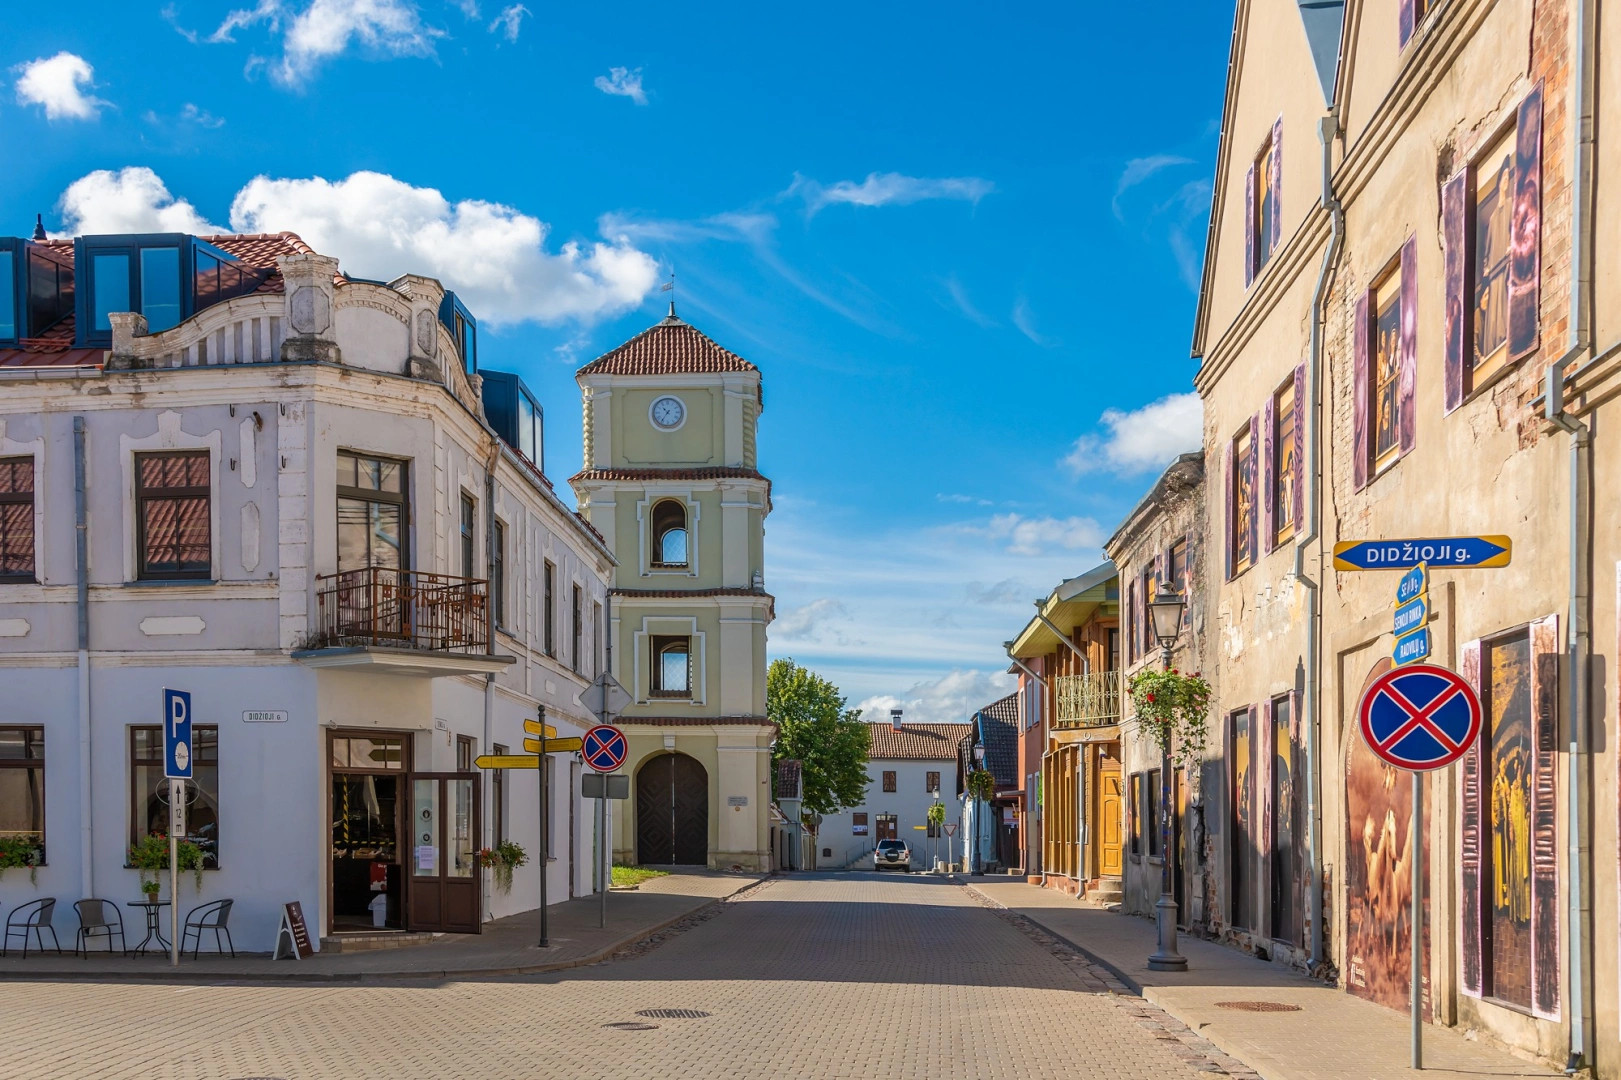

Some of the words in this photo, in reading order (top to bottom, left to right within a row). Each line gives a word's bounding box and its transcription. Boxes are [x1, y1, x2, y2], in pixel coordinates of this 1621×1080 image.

[1366, 542, 1450, 563] DIDŽIOJI
[1455, 548, 1471, 562] g.
[172, 695, 187, 738] P
[175, 808, 182, 818] 12
[175, 823, 182, 832] m
